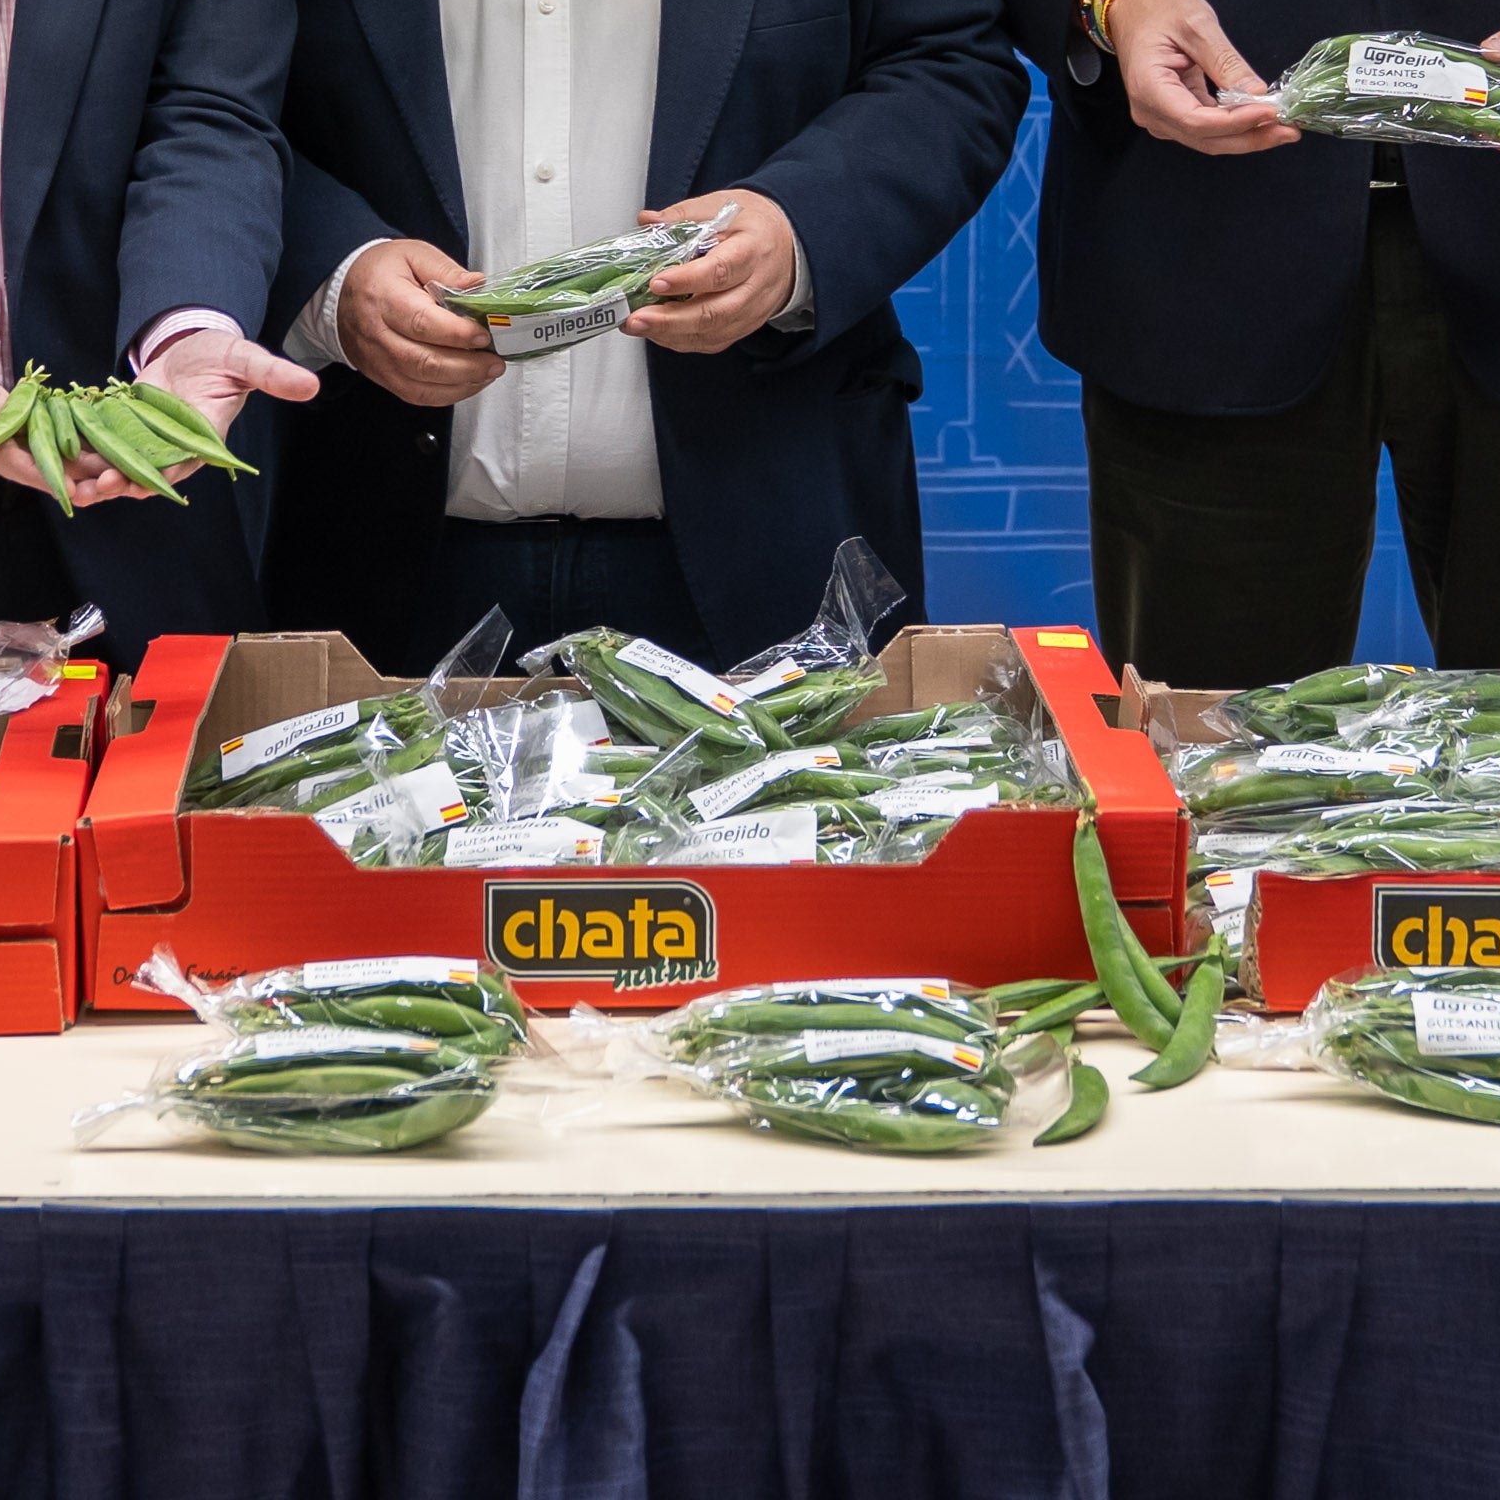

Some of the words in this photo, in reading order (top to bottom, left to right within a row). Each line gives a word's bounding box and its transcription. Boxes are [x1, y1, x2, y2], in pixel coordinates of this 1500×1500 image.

[1354, 66, 1426, 79] GUISANTES
[1354, 78, 1389, 87] PESO:
[1393, 80, 1419, 89] 100g
[533, 308, 616, 342] agroejido
[635, 642, 695, 672] GUISANTES
[263, 710, 346, 758] agroejido
[742, 771, 765, 790] 100g
[454, 831, 531, 848] GUISANTES
[494, 844, 523, 854] 100g
[503, 898, 697, 960] chata
[612, 956, 718, 992] nature
